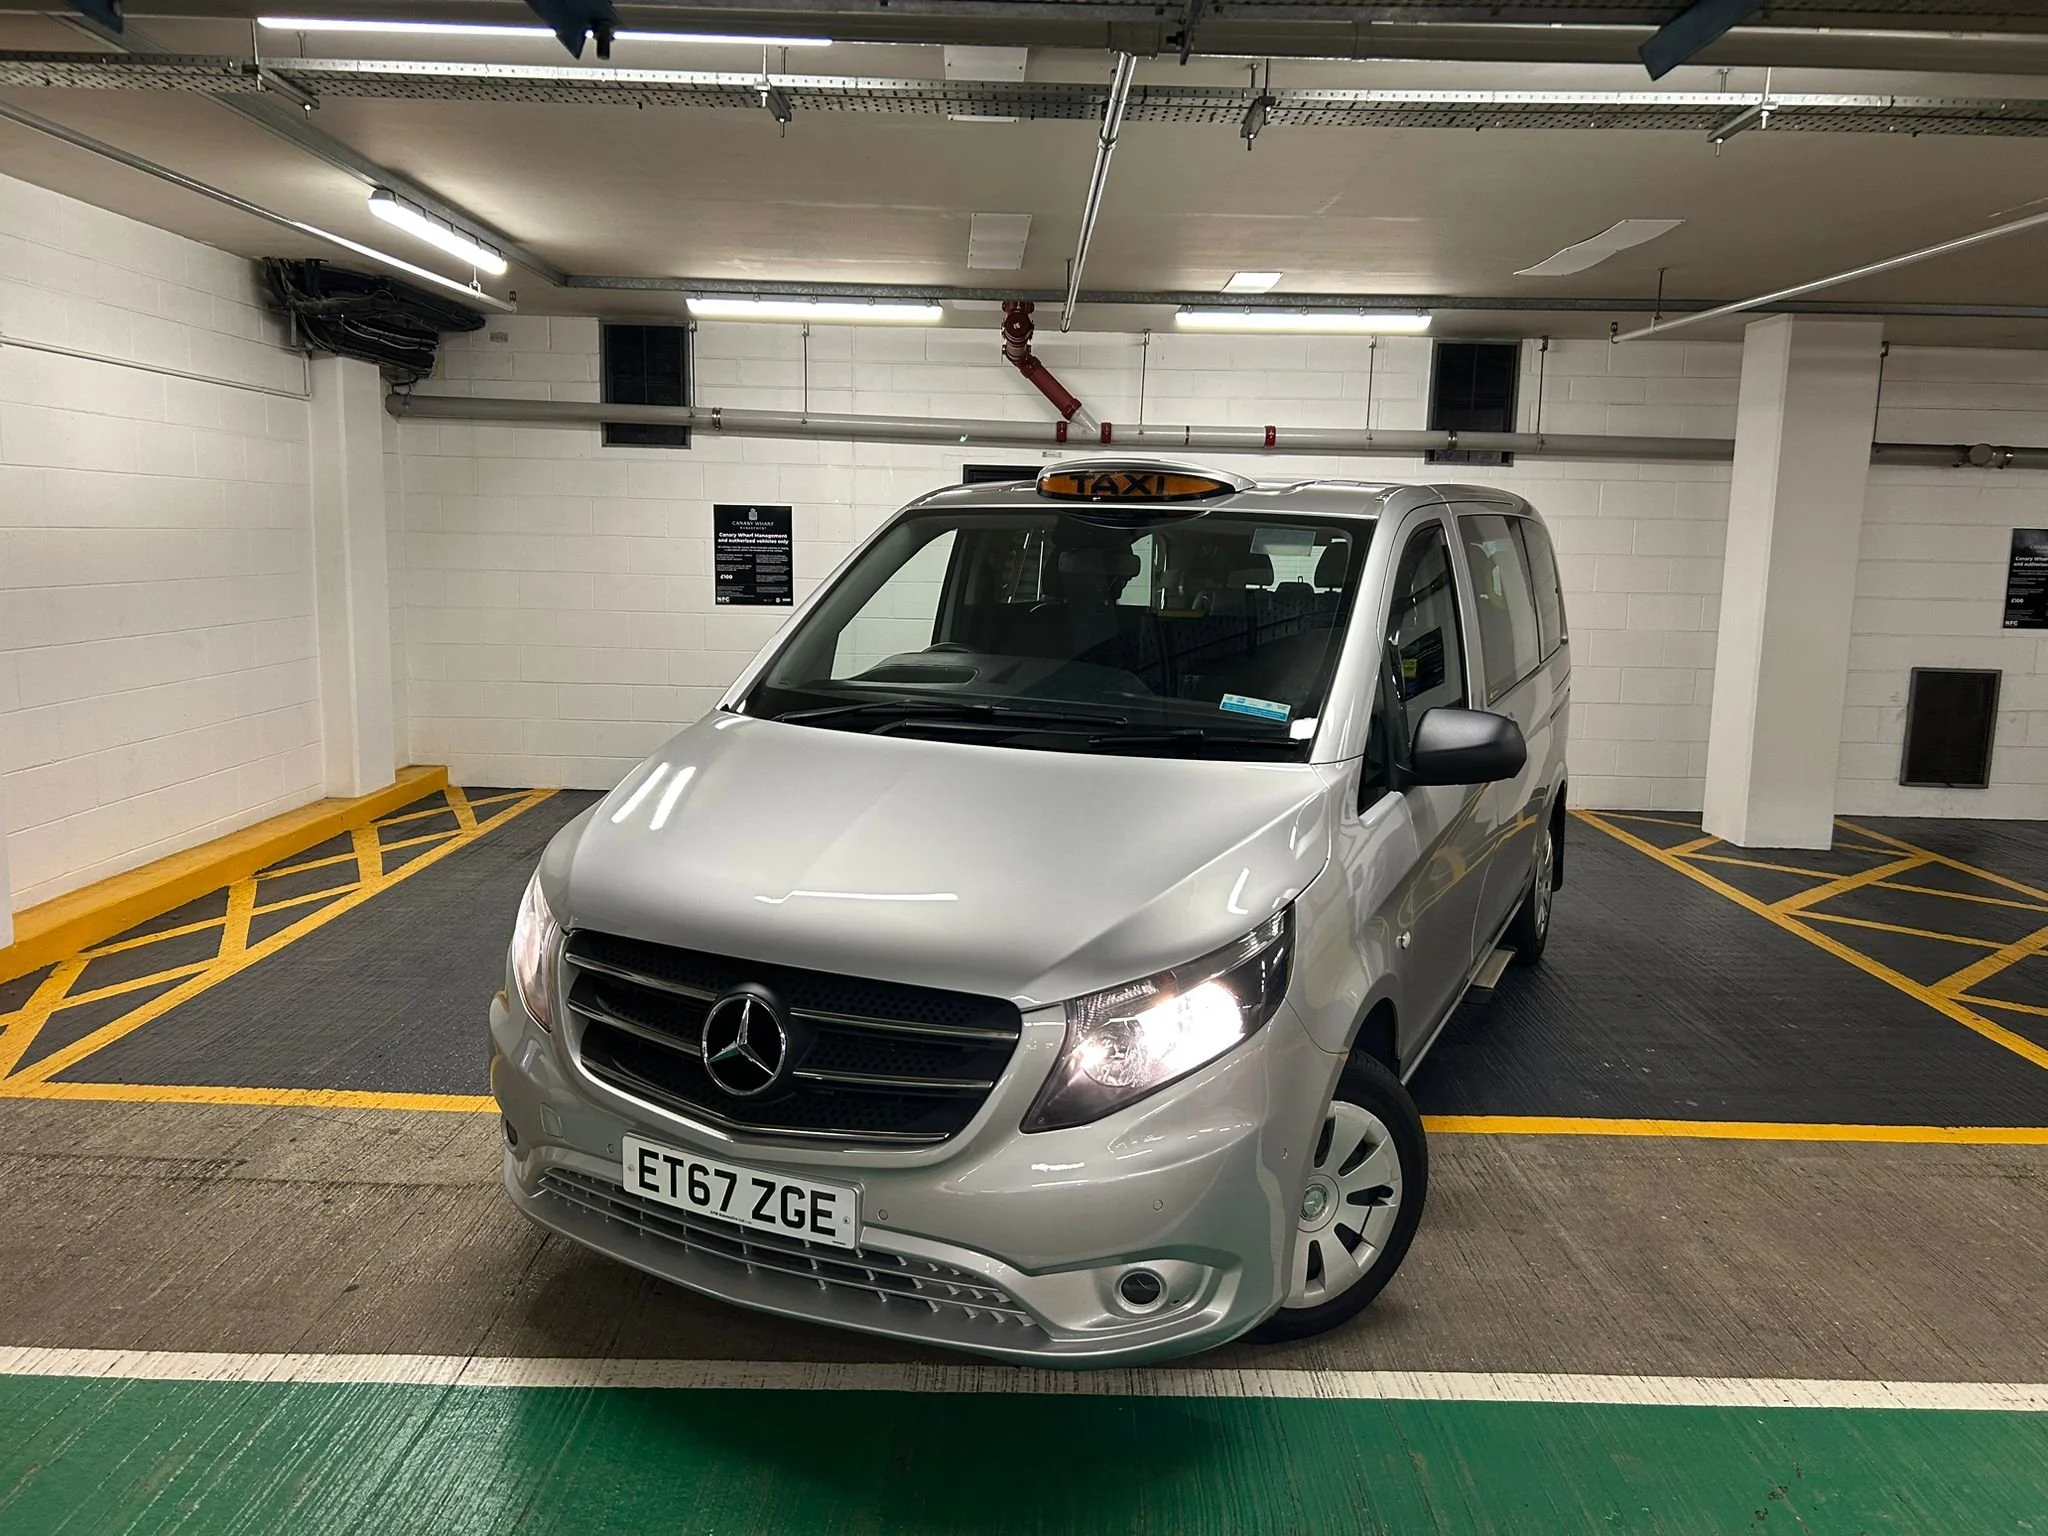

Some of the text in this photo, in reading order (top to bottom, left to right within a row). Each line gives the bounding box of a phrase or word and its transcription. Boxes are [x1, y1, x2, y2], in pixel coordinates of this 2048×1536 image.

[1069, 473, 1165, 496] TAXI
[638, 1147, 836, 1237] ET67 ZGE
